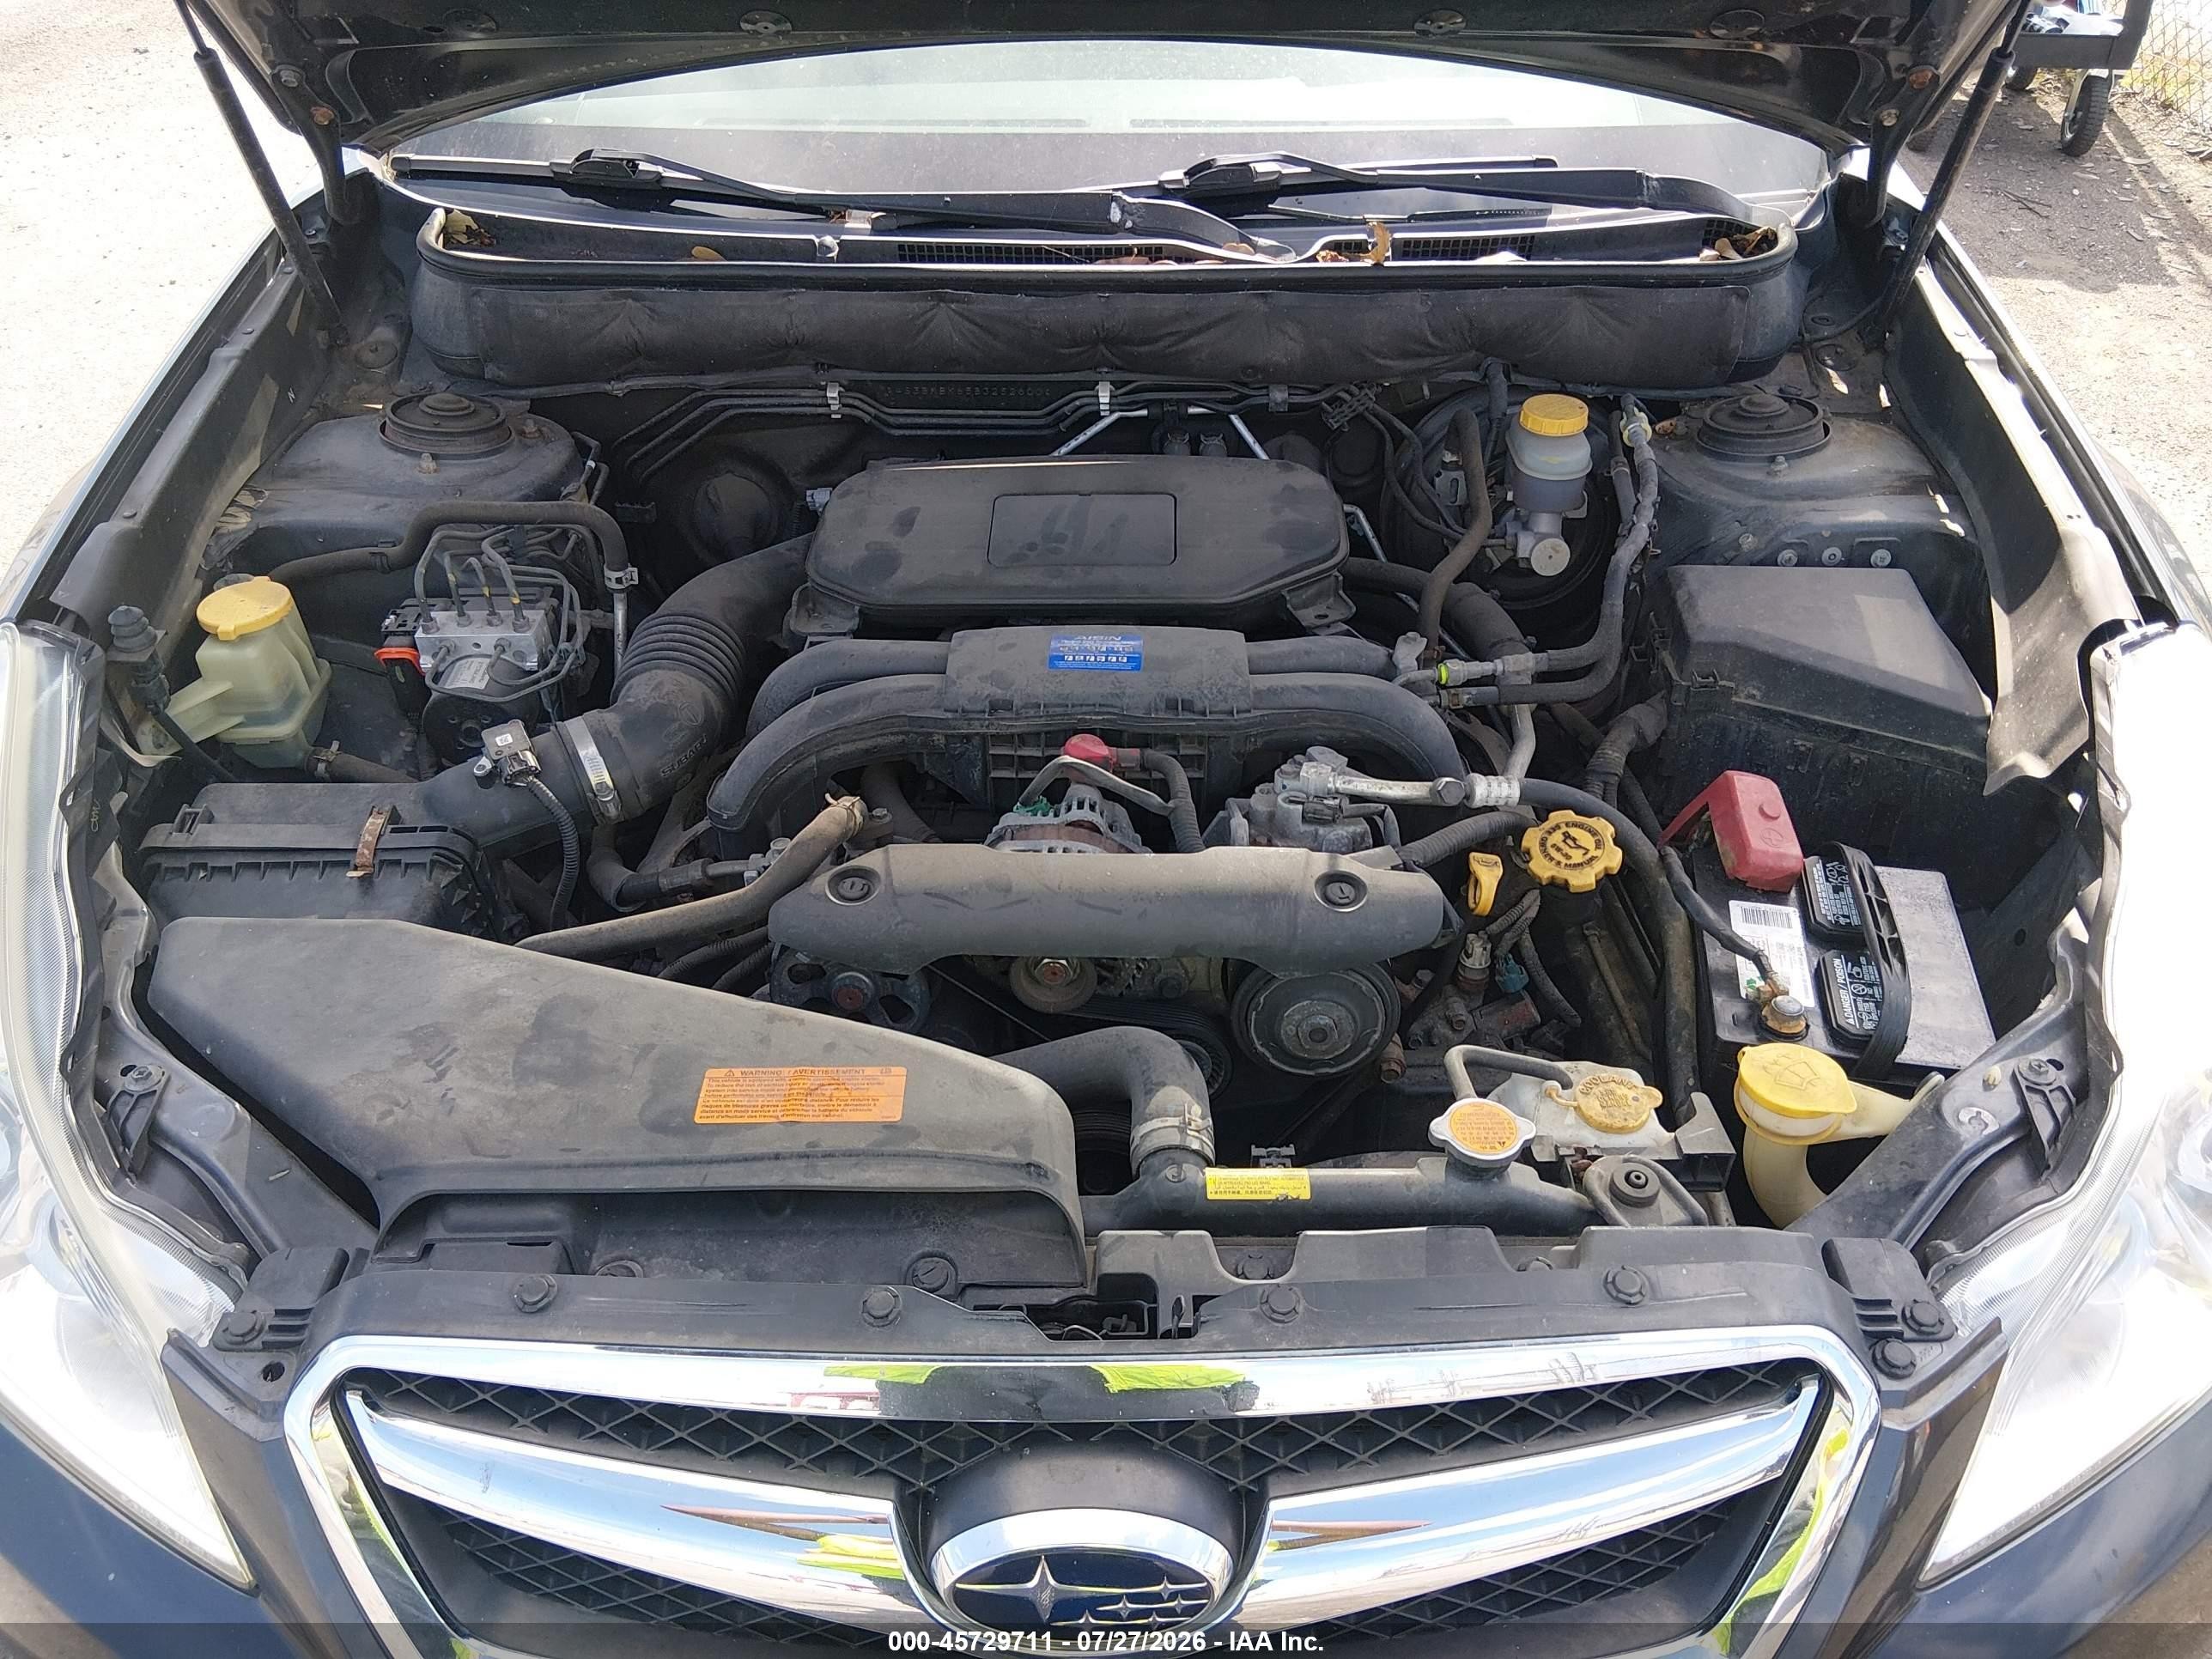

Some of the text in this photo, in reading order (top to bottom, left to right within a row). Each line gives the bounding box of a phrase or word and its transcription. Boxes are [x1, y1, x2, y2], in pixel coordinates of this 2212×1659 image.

[660, 733, 708, 777] SUBARU
[1565, 822, 1602, 851] ENGINE OIL
[1564, 854, 1599, 869] MANUAL
[1832, 958, 1847, 984] POISON
[1839, 988, 1855, 1018] DANGER
[1579, 1075, 1637, 1095] COOLANT
